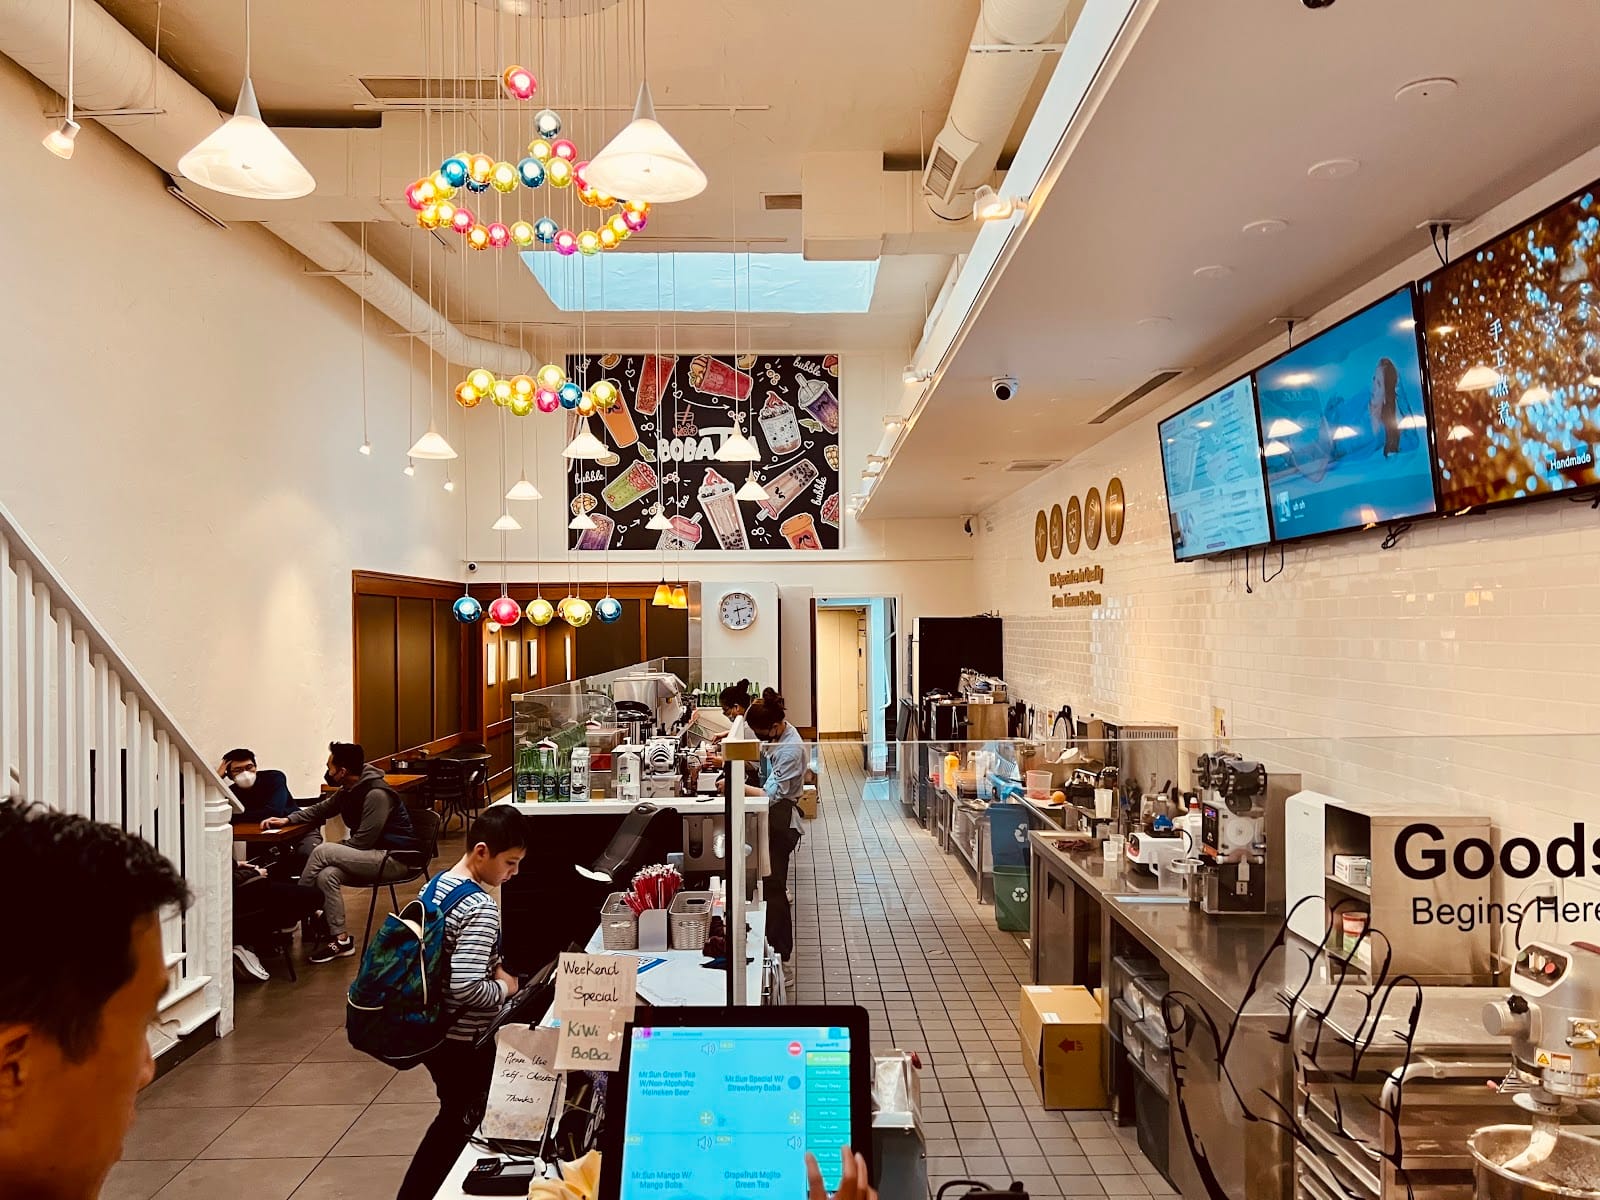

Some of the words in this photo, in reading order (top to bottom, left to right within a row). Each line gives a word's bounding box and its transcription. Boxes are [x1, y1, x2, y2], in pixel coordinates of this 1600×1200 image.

[793, 356, 821, 376] bubble
[658, 436, 716, 462] BOBA
[1551, 452, 1591, 470] Handmade
[575, 470, 605, 485] bubble
[810, 476, 827, 506] bubble
[1394, 822, 1600, 880] Good
[1412, 896, 1522, 932] Begins
[573, 986, 618, 1007] Special
[505, 1051, 526, 1065] Please
[532, 1055, 548, 1066] Use
[724, 1171, 758, 1180] Grapefruit
